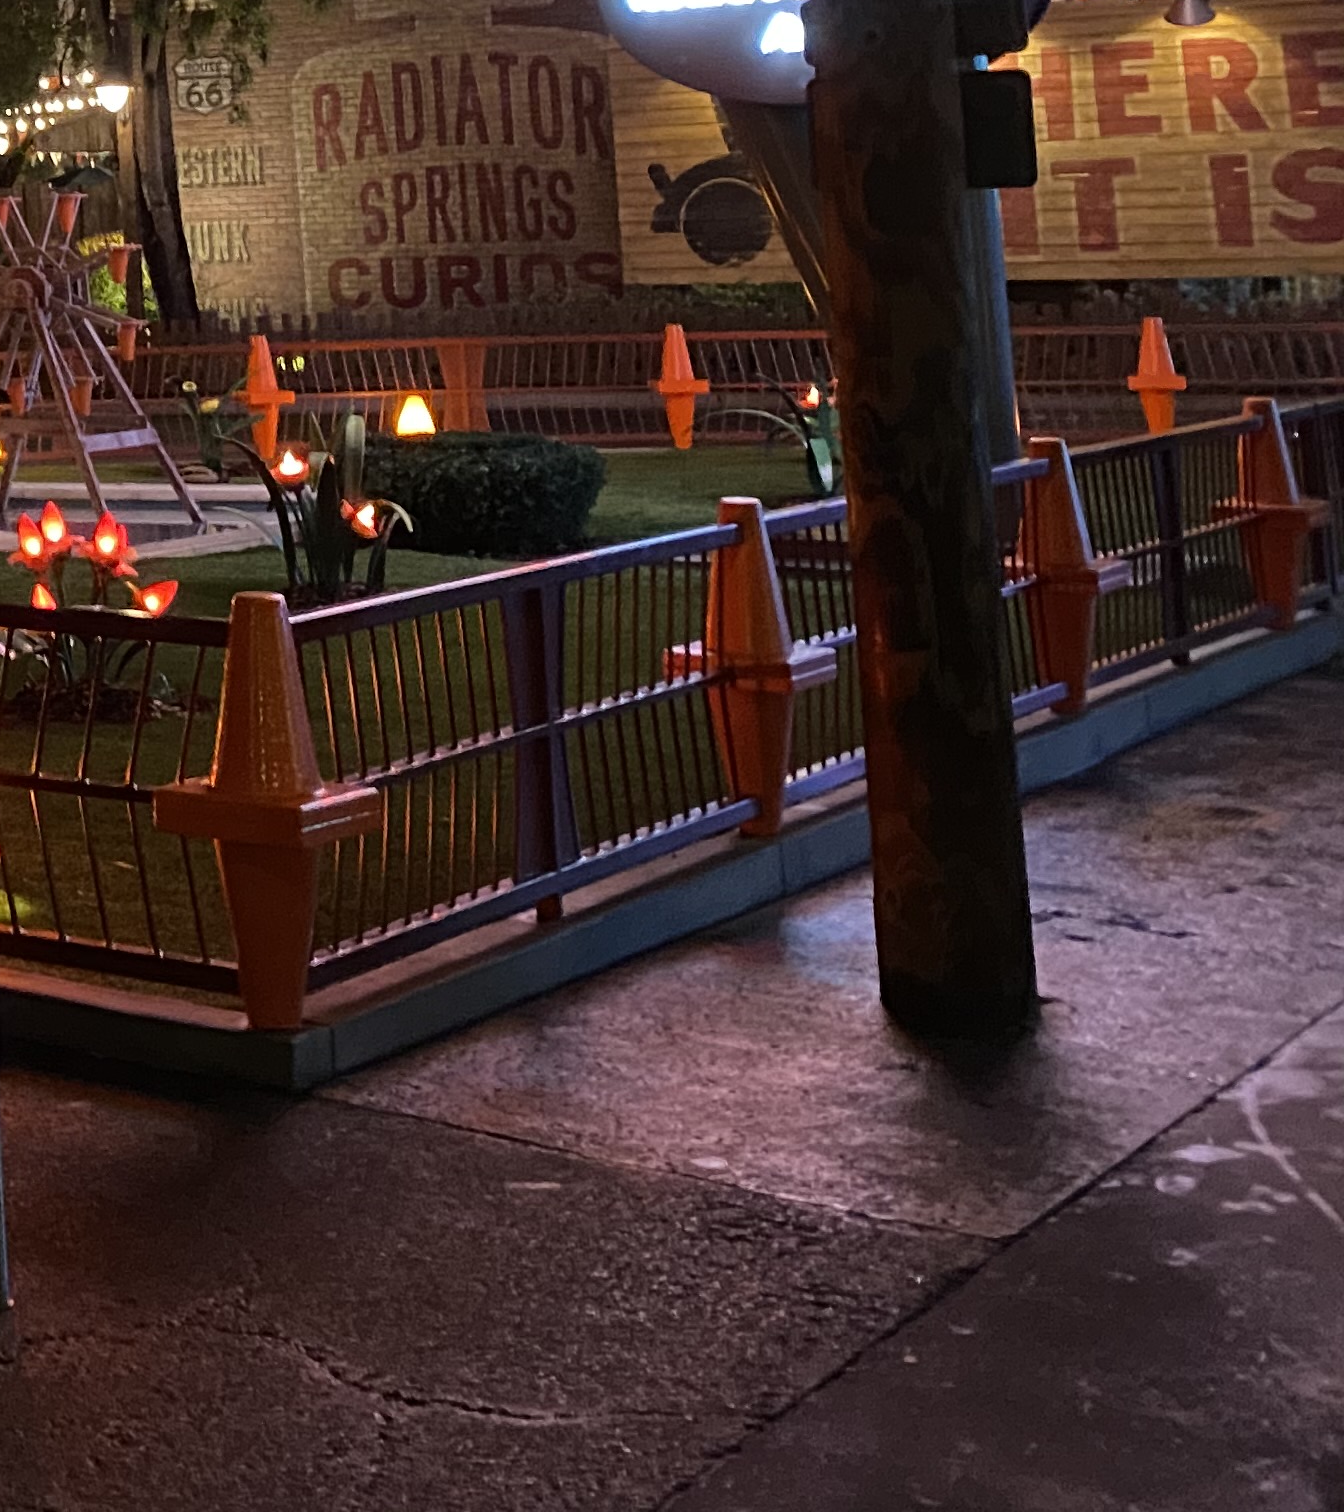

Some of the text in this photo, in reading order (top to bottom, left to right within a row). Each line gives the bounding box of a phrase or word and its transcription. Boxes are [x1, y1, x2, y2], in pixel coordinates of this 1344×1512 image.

[186, 80, 223, 108] 66
[312, 50, 610, 172] RADIATOR
[177, 145, 263, 186] ESTERN
[359, 162, 578, 246] SPRINGS
[1208, 147, 1344, 250] IS
